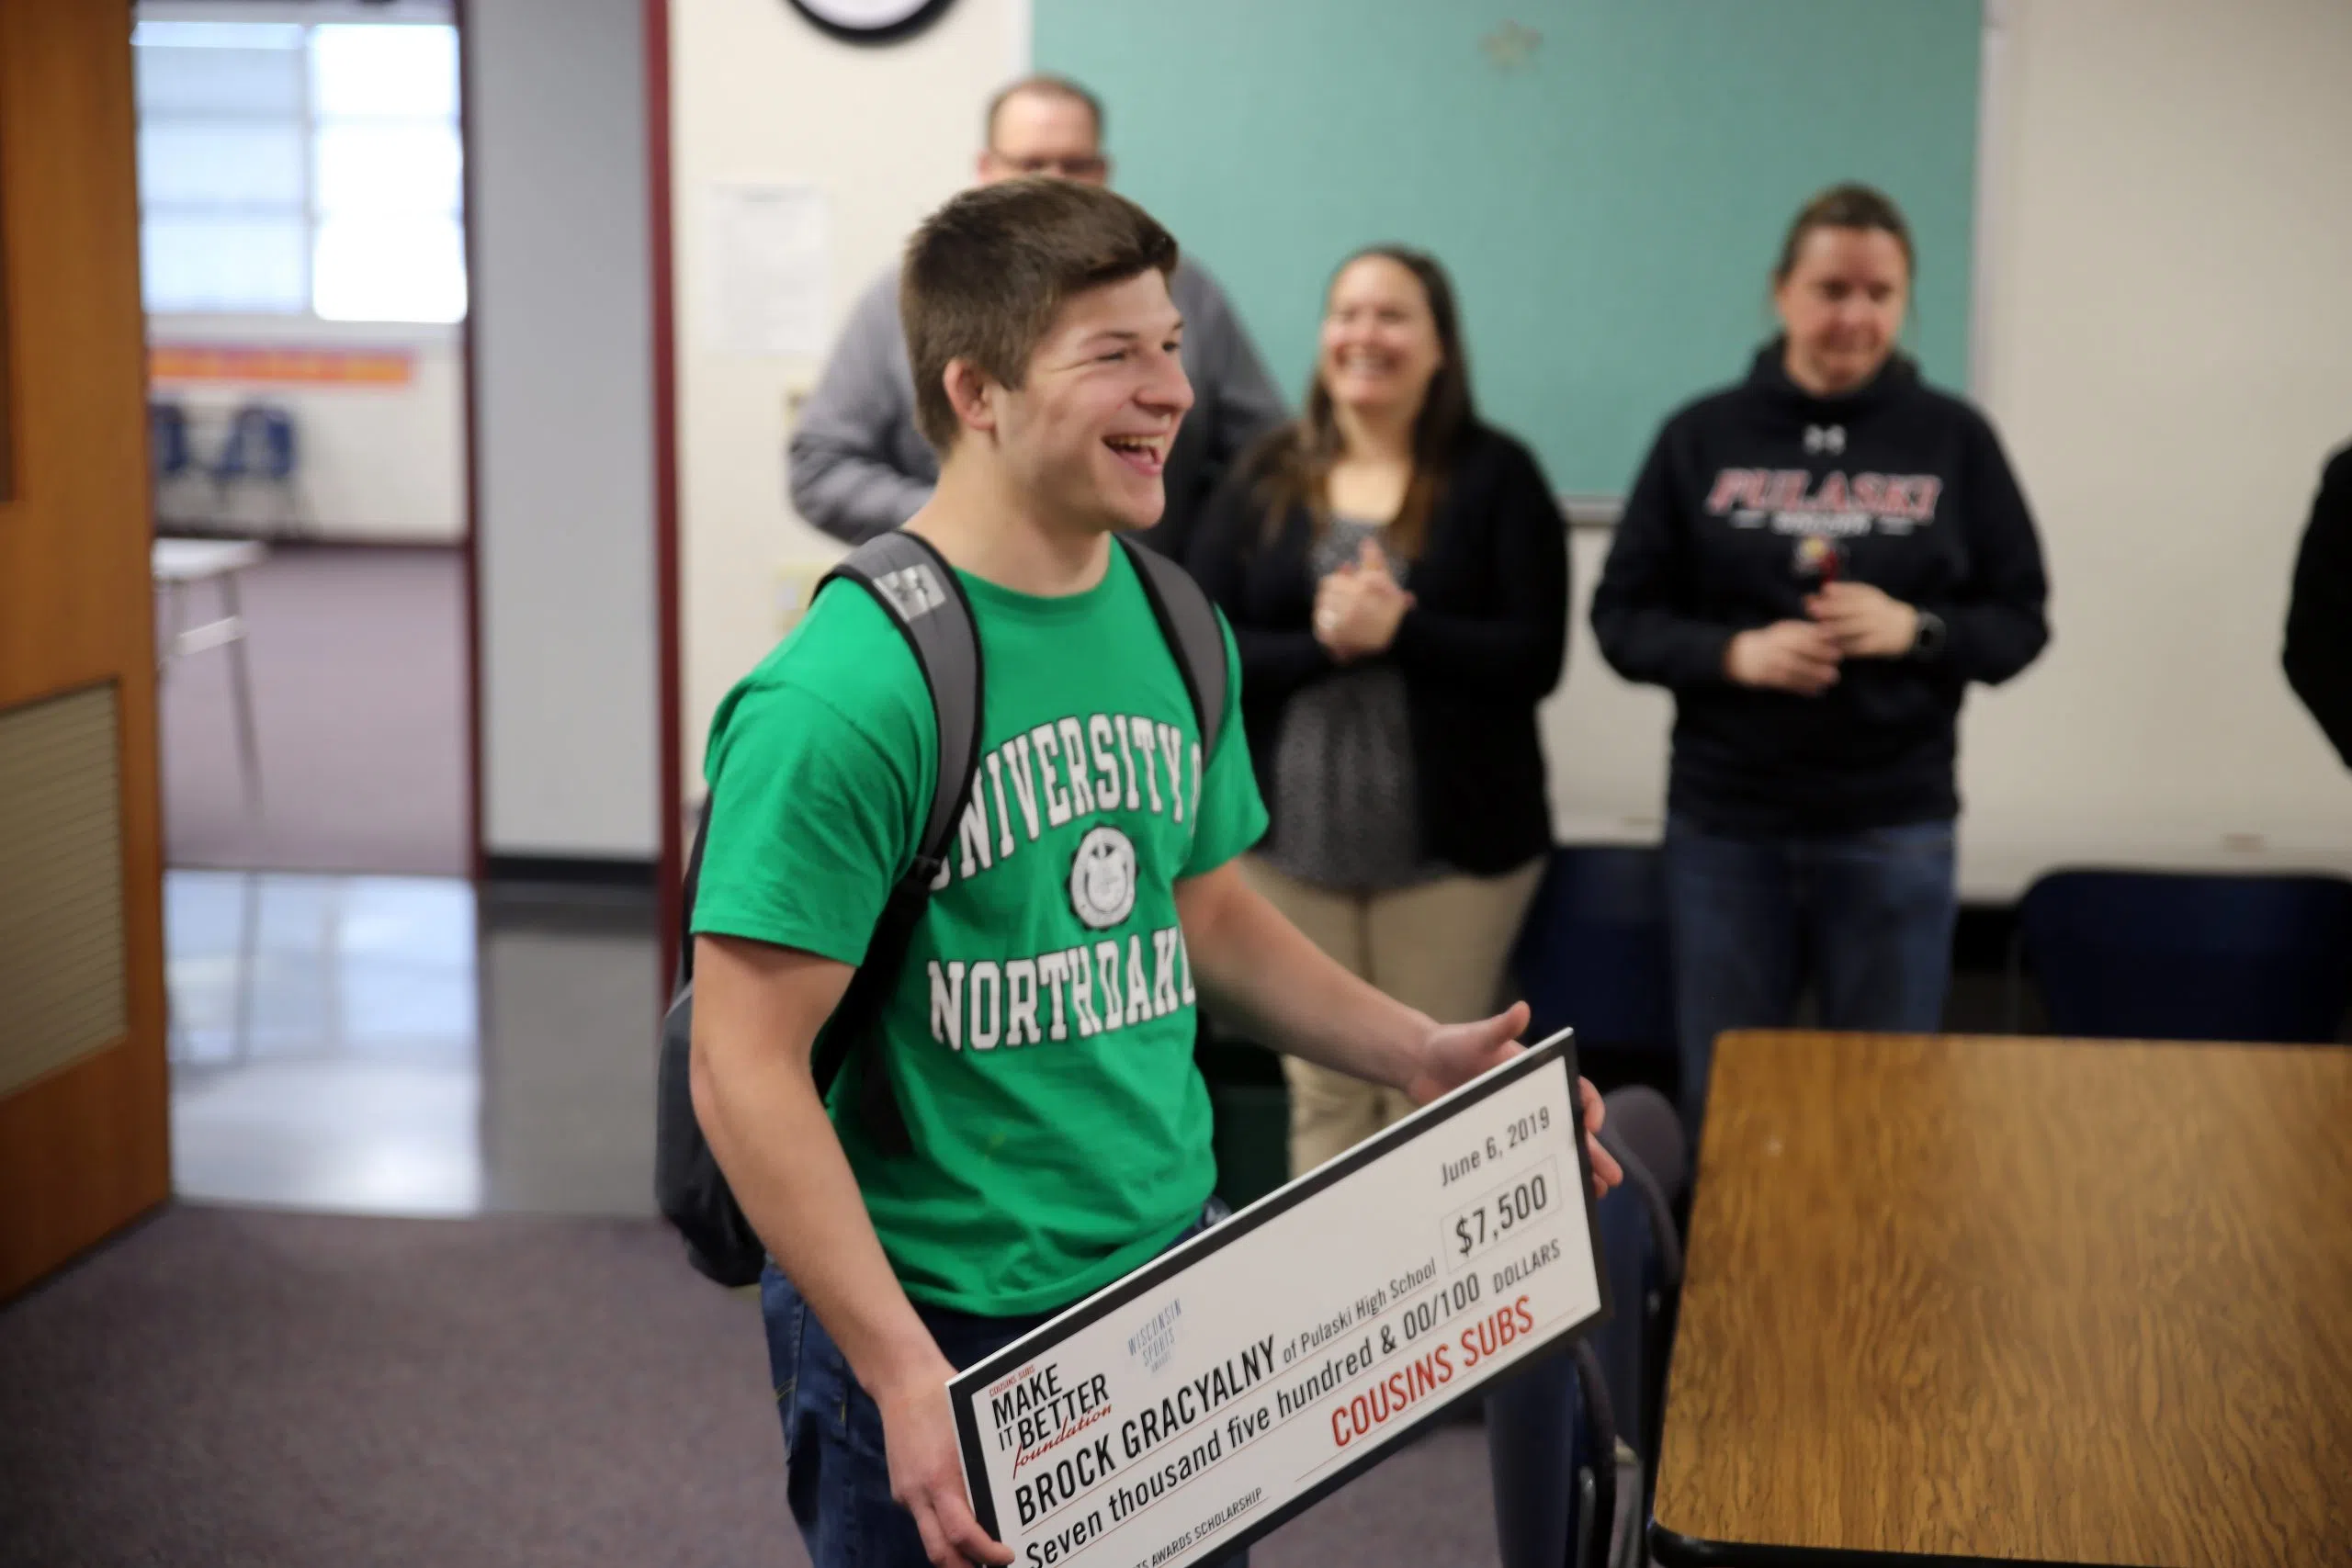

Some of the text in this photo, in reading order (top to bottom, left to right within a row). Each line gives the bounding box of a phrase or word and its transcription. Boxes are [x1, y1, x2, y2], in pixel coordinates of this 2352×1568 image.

[930, 714, 1182, 891] NIVERSITY
[927, 945, 1102, 1051] NORTH
[1441, 1106, 1551, 1187] June 6, 2019
[1455, 1174, 1547, 1257] $7,500
[991, 1363, 1062, 1428] MAKE
[999, 1373, 1110, 1451] IT BETTER
[1015, 1433, 1116, 1526] BROCK
[1122, 1334, 1274, 1459] GRACYALNY
[1283, 1341, 1296, 1364] of
[1301, 1306, 1352, 1353] Pulaski
[1355, 1290, 1386, 1320] High
[1390, 1258, 1436, 1299] School
[1026, 1238, 1561, 1568] Seven thousand five hundred & 00/100 DOLLARS
[1331, 1294, 1533, 1447] COUSINS SUBS
[1012, 1403, 1112, 1480] foundation
[1152, 1487, 1262, 1567] AWARDS SCHOLARSHIP
